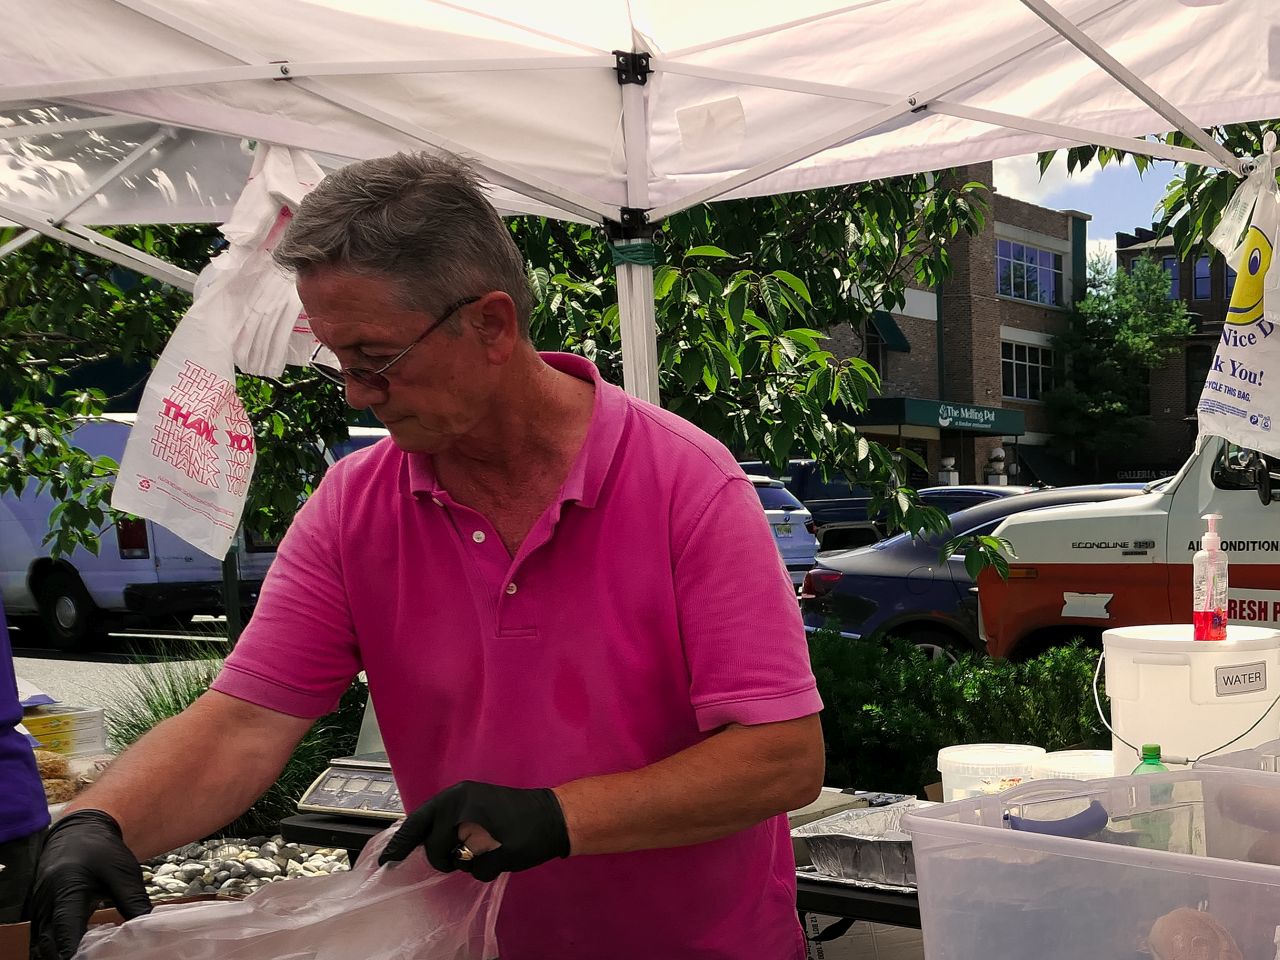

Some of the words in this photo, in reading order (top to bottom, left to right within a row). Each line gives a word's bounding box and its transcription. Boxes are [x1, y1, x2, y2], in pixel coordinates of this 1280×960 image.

[1230, 358, 1264, 387] You!
[1224, 385, 1237, 398] THIS
[946, 405, 959, 417] The
[984, 410, 995, 421] Pot
[151, 438, 220, 489] THANK
[1071, 541, 1129, 549] ECONOLINE
[1227, 599, 1269, 621] RESH
[1222, 671, 1262, 686] WATER
